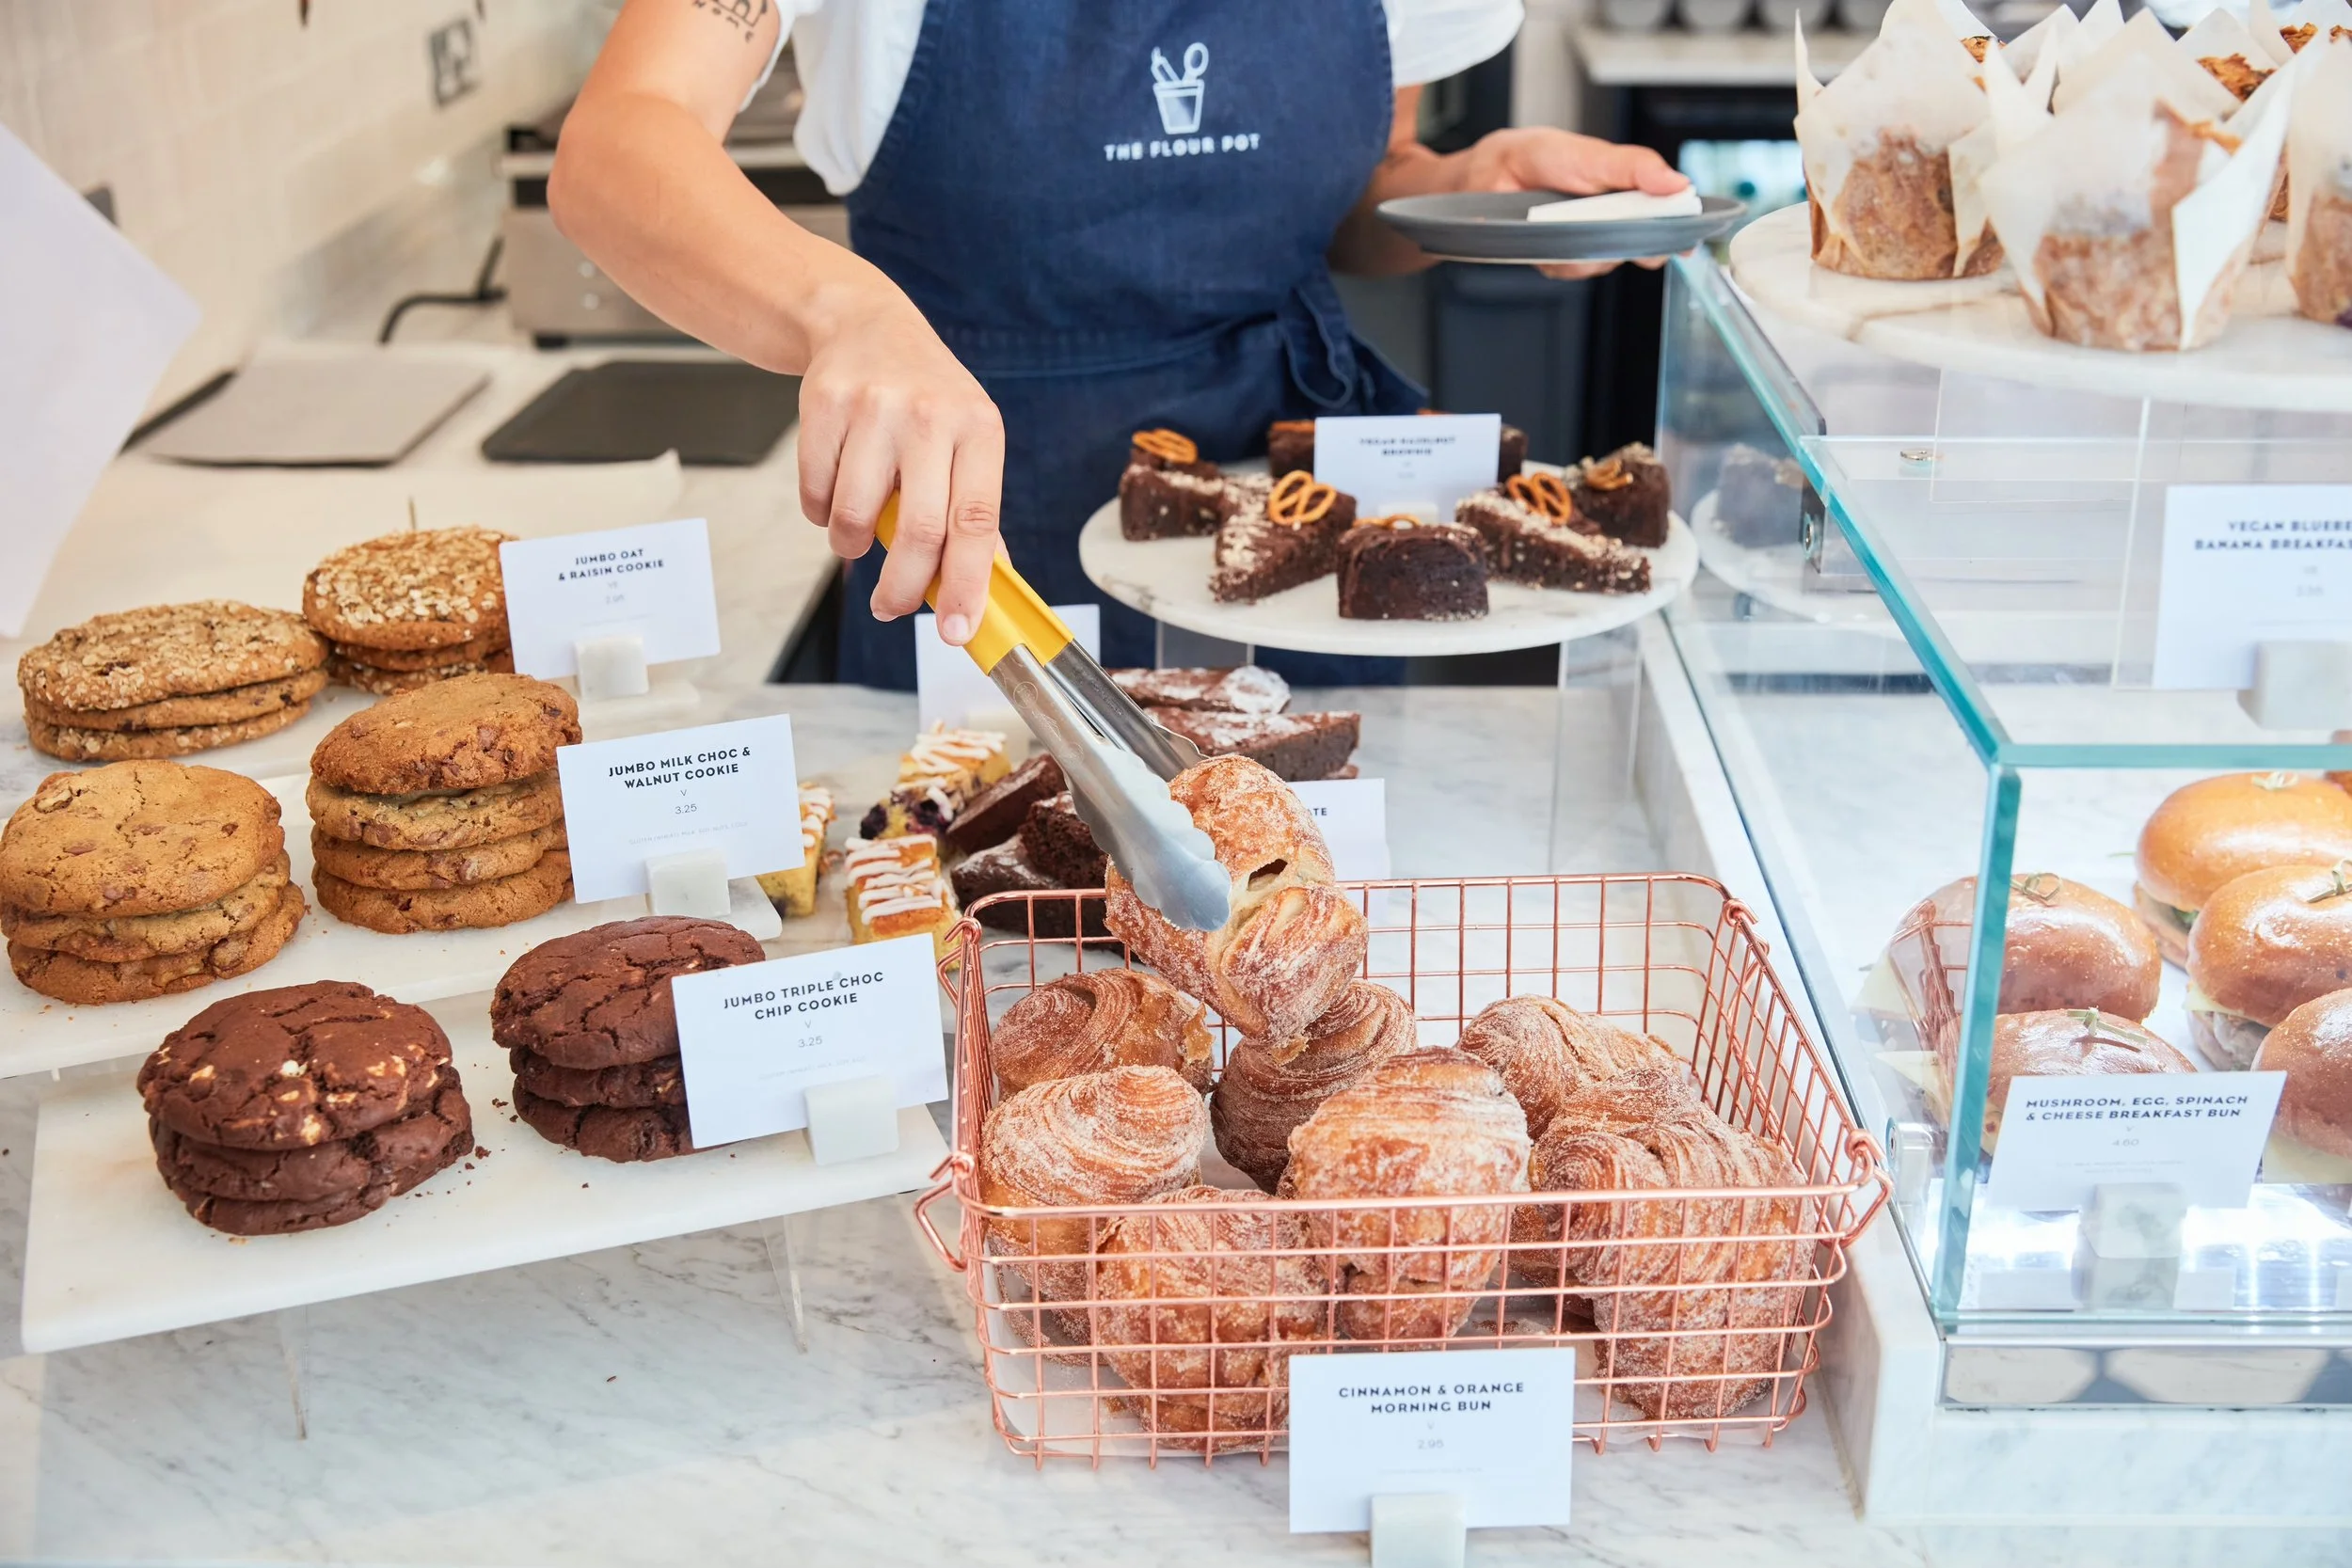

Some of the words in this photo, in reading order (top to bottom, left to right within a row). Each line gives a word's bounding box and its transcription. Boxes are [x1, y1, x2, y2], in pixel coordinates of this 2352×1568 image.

[1104, 141, 1143, 162] THE
[1150, 136, 1215, 158] FLOUR
[1221, 134, 1261, 152] POT
[2229, 521, 2284, 532] VEGAN
[2194, 539, 2264, 550] BANANA
[576, 552, 616, 565] JUMBO
[621, 548, 644, 559] OAT
[558, 573, 565, 581] &
[570, 566, 612, 579] RAISIN
[617, 560, 663, 573] COOKIE
[609, 760, 656, 777] JUMBO
[661, 756, 693, 769] MILK
[697, 748, 738, 763] CHOC
[742, 746, 751, 756] &
[625, 773, 680, 788] WALNUT
[685, 763, 739, 780] COOKIE
[675, 803, 697, 815] 3.25
[723, 992, 776, 1010] JUMBO
[781, 982, 834, 999] TRIPLE
[839, 971, 884, 989] CHOC
[755, 1005, 792, 1020] CHIP
[798, 992, 857, 1011] COOKIE
[804, 1020, 812, 1029] V
[798, 1035, 823, 1048] 3.25
[2175, 1095, 2249, 1105] SPINACH
[2026, 1112, 2036, 1121] &
[2042, 1110, 2105, 1120] CHEESE
[2109, 1108, 2202, 1119] BREAKFAST
[2208, 1108, 2242, 1117] BUN
[1339, 1385, 1432, 1399] CINNAMON
[1438, 1385, 1448, 1395] &
[1454, 1382, 1525, 1395] ORANGE
[1371, 1402, 1452, 1414] MORNING
[1457, 1400, 1491, 1412] BUN
